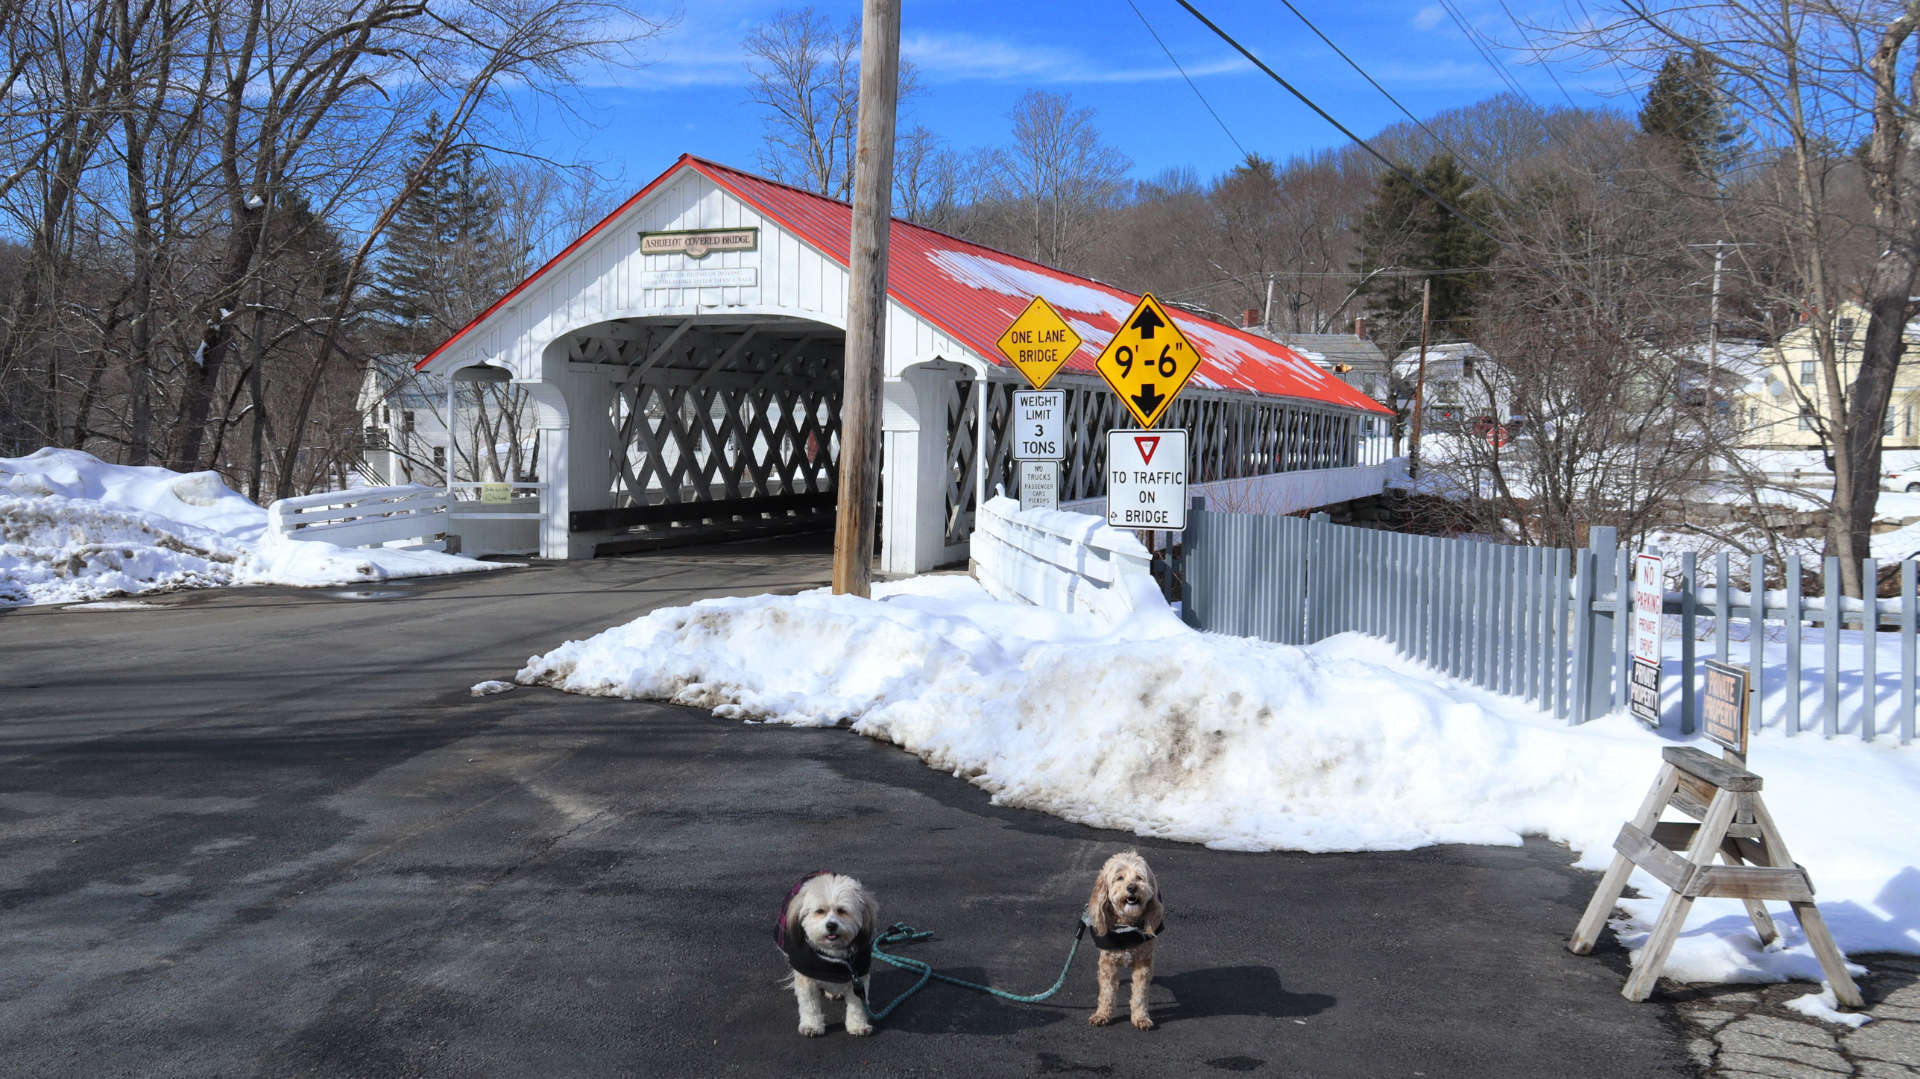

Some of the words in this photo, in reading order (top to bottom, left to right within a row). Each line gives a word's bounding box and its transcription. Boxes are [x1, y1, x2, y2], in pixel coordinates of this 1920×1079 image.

[645, 238, 681, 249] ASHUELOT
[685, 236, 720, 247] COVERED
[722, 235, 751, 245] BRIDGE
[1011, 331, 1032, 344] ONE
[1038, 330, 1066, 343] LANE
[1019, 349, 1058, 362] BRIDGE
[1020, 396, 1058, 407] WEIGHT
[1026, 410, 1051, 420] LIMIT
[1034, 424, 1044, 437] 3
[1022, 441, 1056, 454] TONS
[1112, 471, 1126, 484] TO
[1133, 471, 1183, 485] TRAFFIC
[1139, 490, 1155, 504] ON
[1125, 510, 1168, 523] BRIDGE
[1644, 566, 1654, 585] NO
[1636, 591, 1660, 614] PARKING
